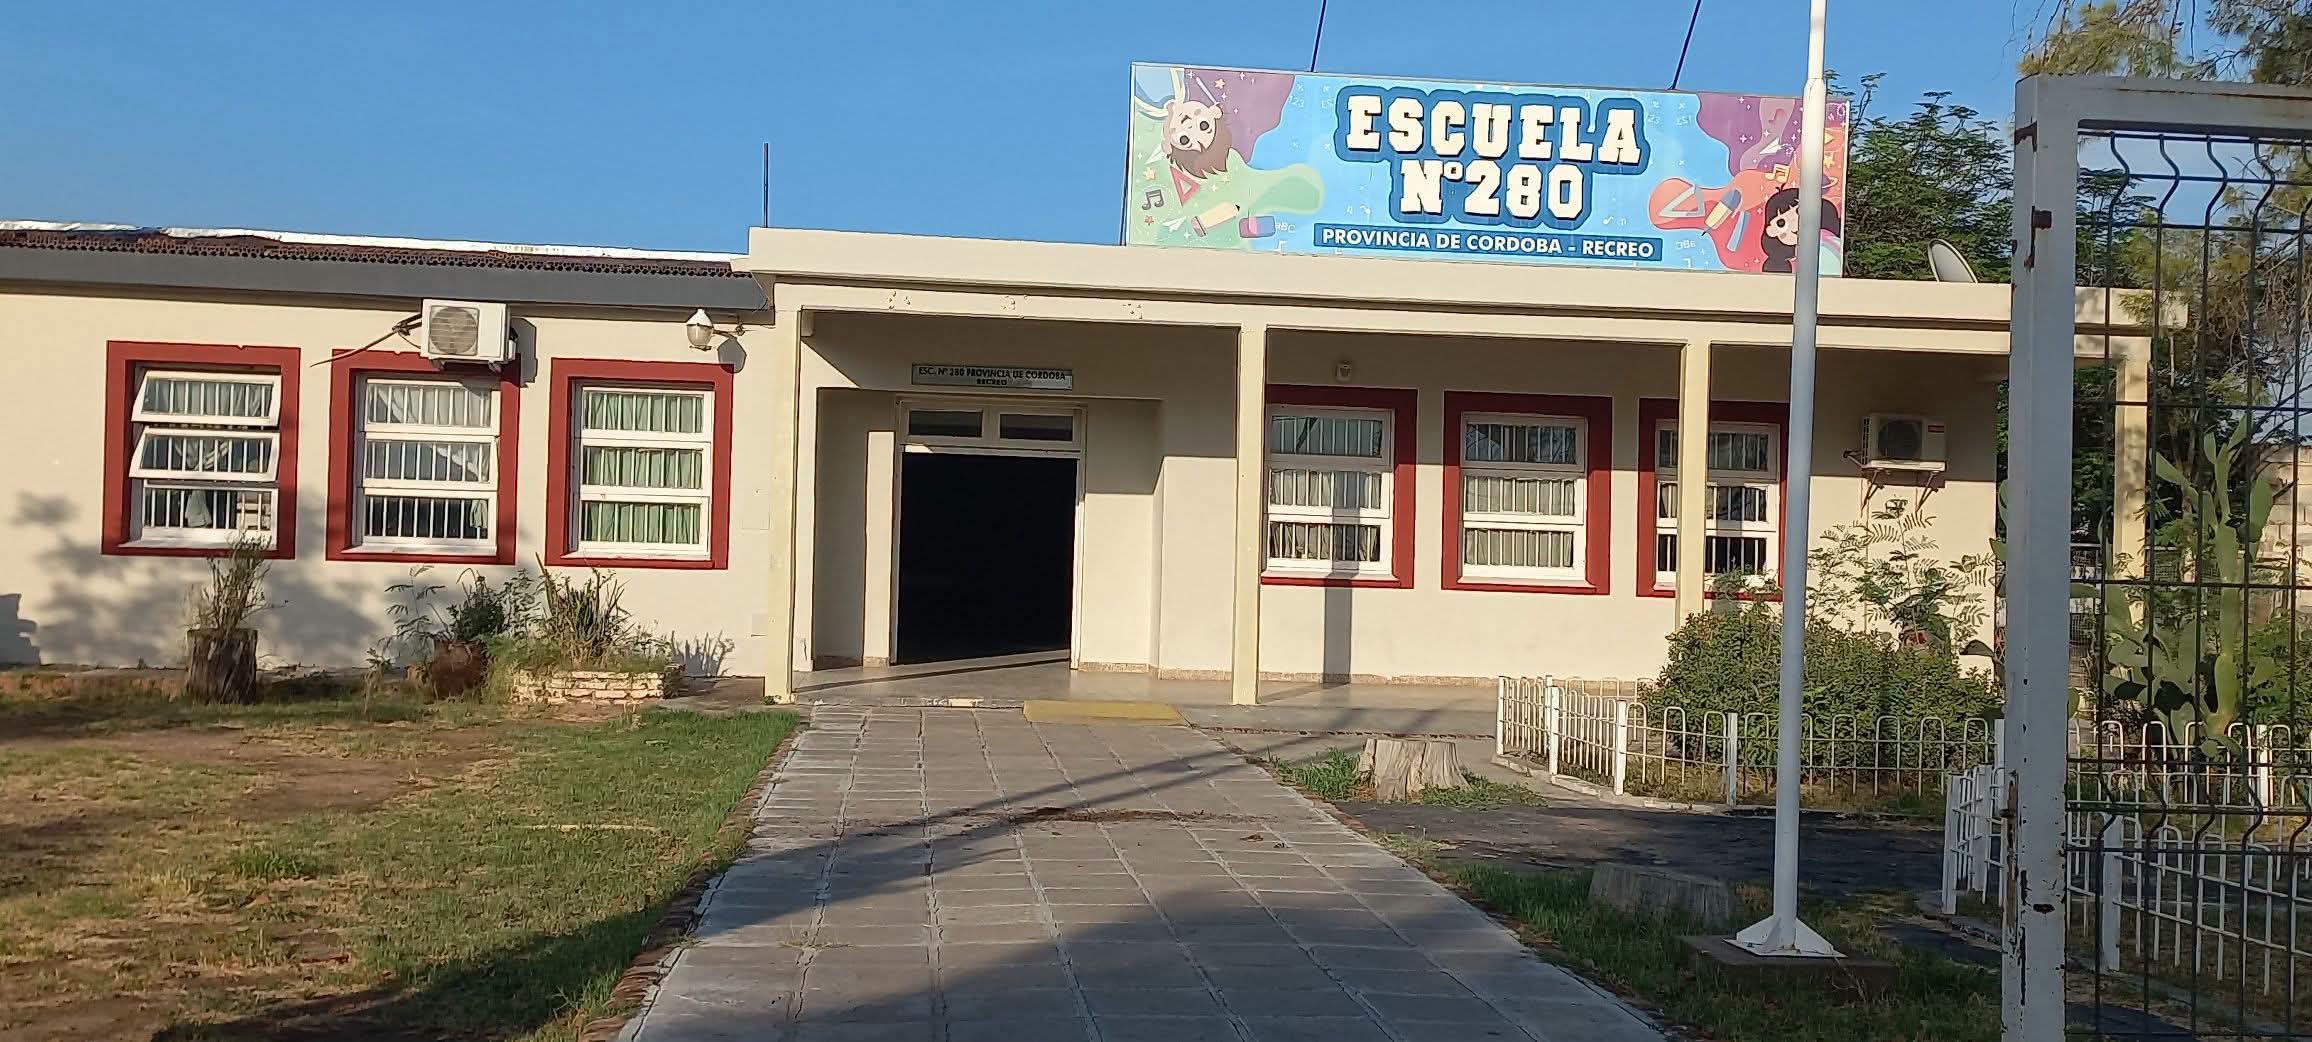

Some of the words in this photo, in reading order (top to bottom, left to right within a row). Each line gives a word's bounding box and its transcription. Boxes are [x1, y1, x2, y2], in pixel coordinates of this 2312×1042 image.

[1346, 95, 1641, 165] ESCUELA
[1322, 228, 1431, 249] PROVINCIA
[1436, 233, 1461, 249] DE
[1466, 235, 1563, 254] CORDOBA
[1582, 239, 1655, 258] RECREO
[966, 368, 1011, 378] PROVINCIA
[1013, 370, 1024, 379] DE
[1026, 370, 1066, 380] CORDOBA
